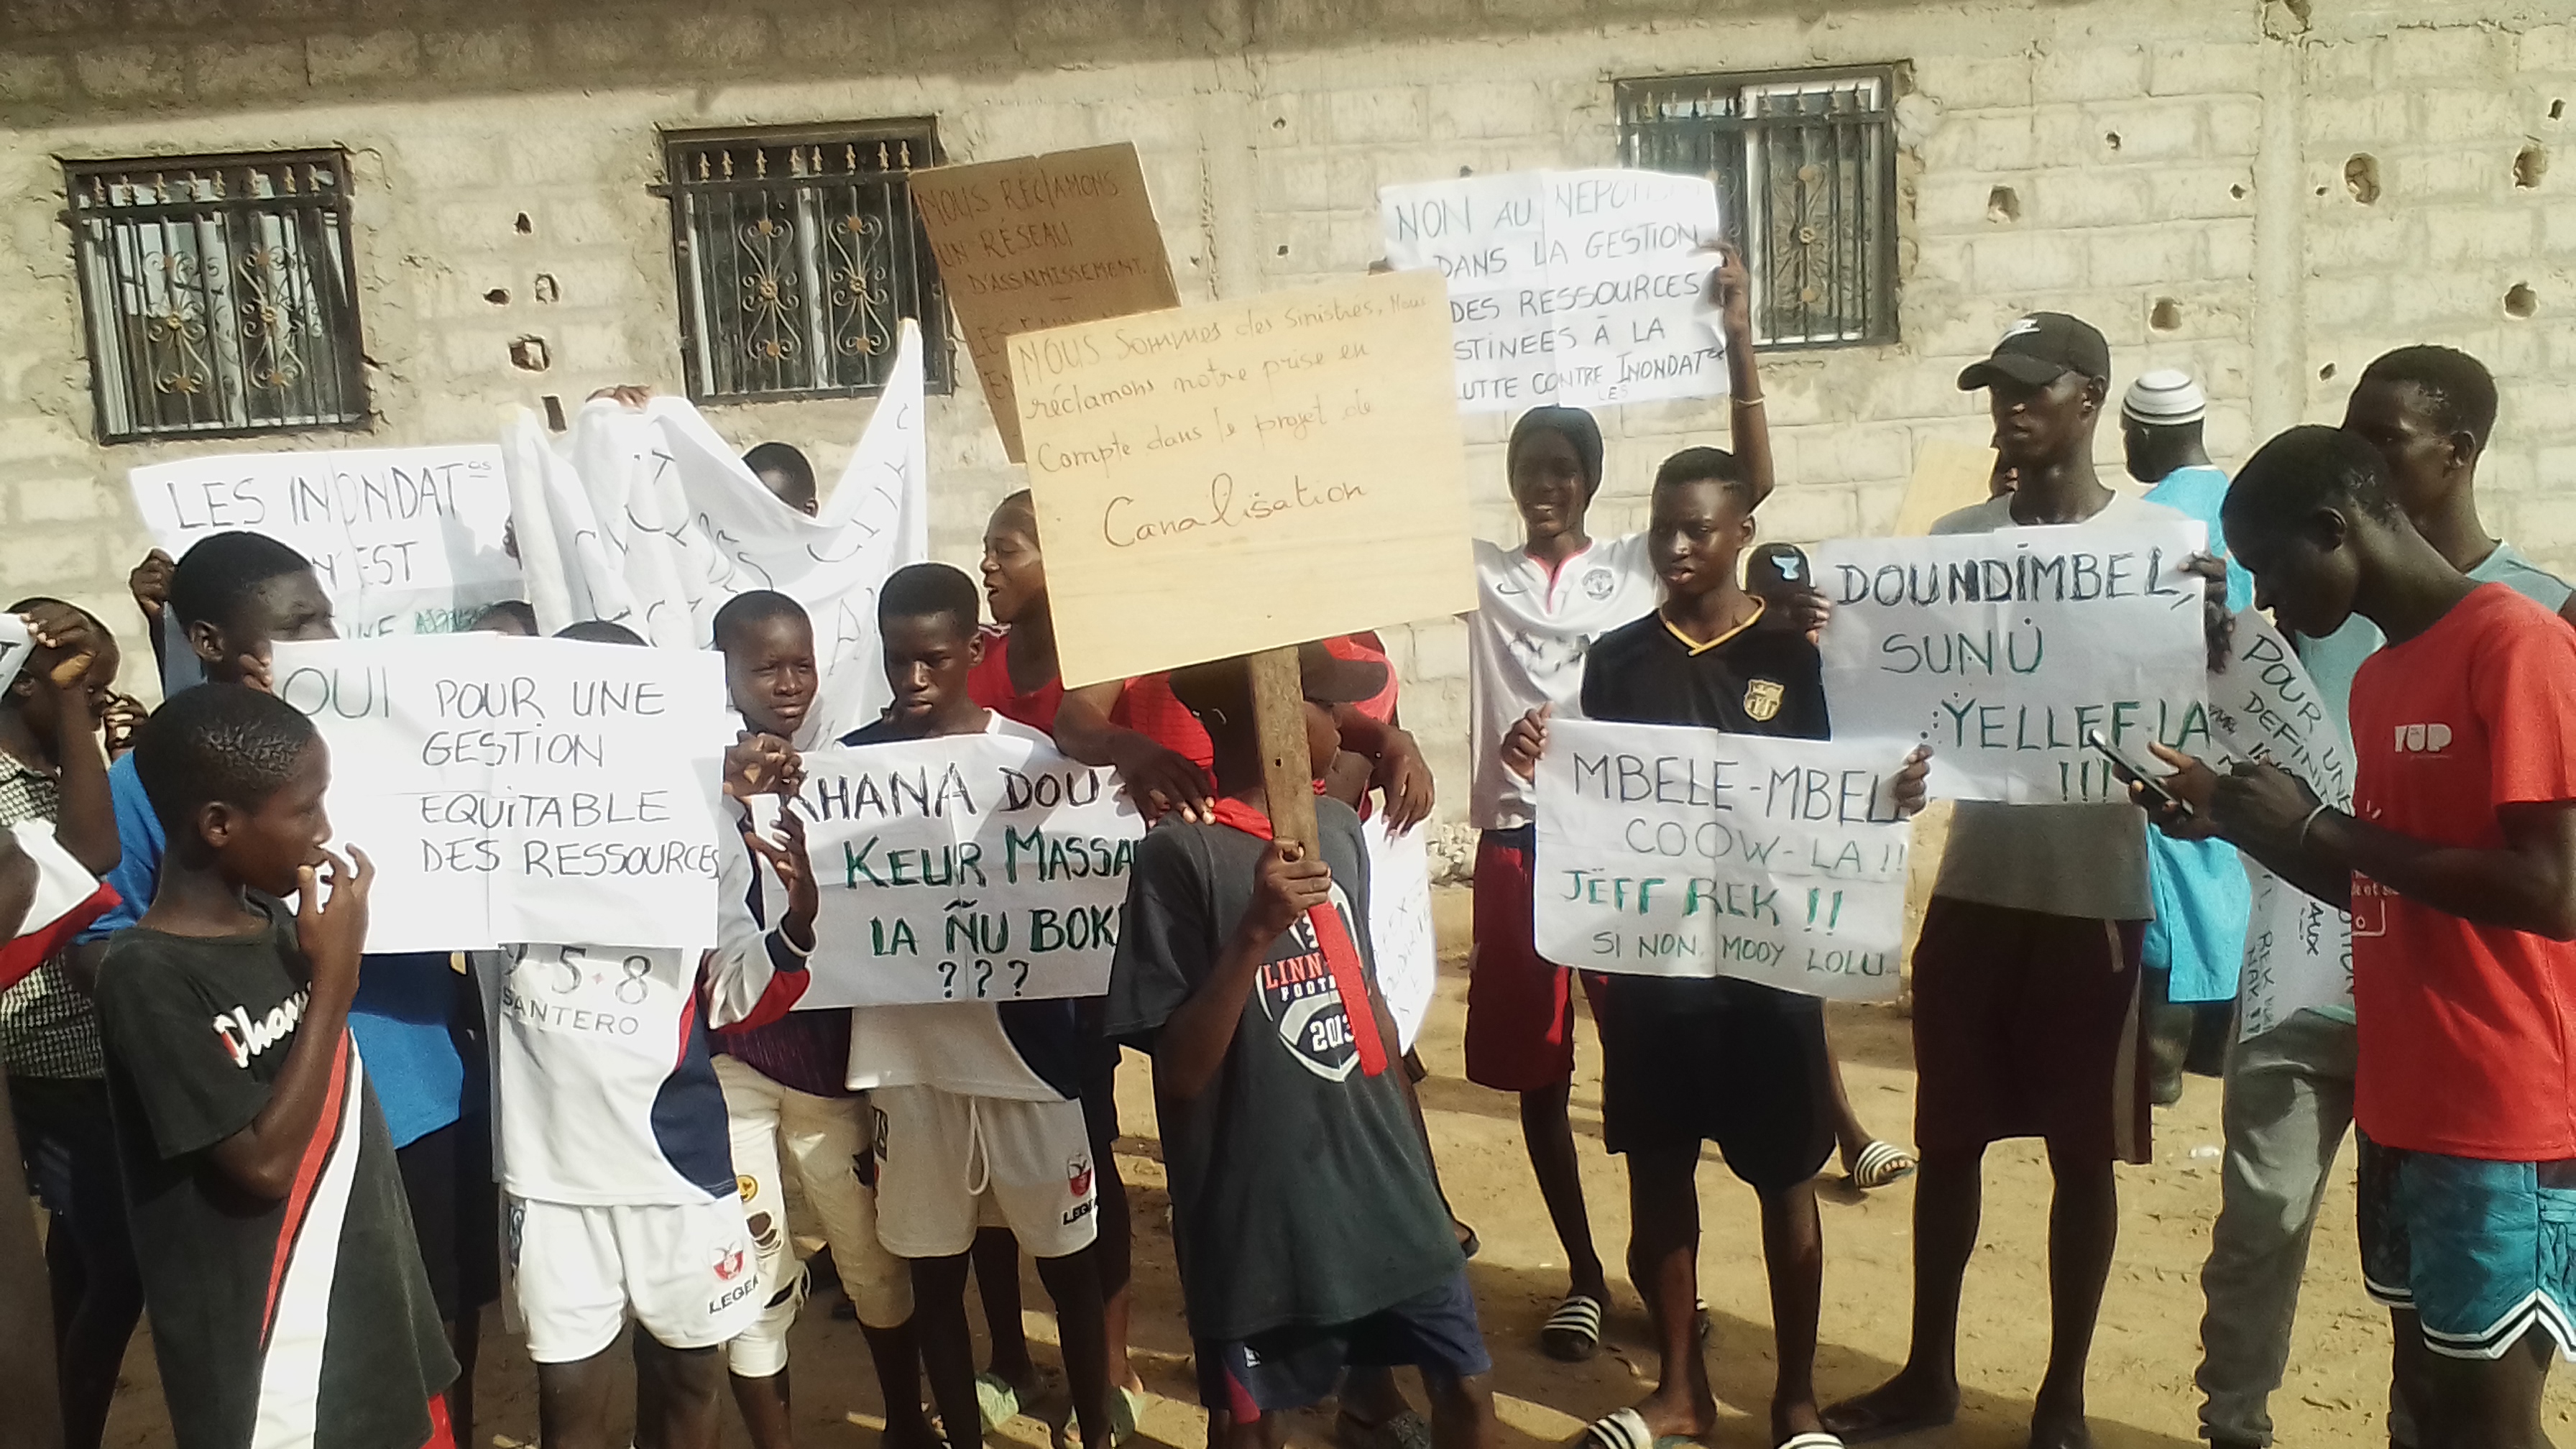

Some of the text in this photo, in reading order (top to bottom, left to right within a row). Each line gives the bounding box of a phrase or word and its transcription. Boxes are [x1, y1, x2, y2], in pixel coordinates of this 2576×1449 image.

[918, 186, 990, 226] NOUS
[1397, 196, 1472, 242] NON
[1493, 198, 1532, 229] AU
[938, 239, 969, 269] UN
[1434, 222, 1702, 279] DANS LA GESTION
[1449, 272, 1701, 323] DES RESSOURCES
[1018, 334, 1100, 387] NOUS
[1236, 309, 1272, 337] des
[1632, 316, 1666, 344] LA
[1025, 341, 1371, 420] réclamons notre prise en
[1532, 364, 1604, 395] CONTRE
[1598, 385, 1629, 400] LES
[1037, 431, 1131, 479] Compte
[1146, 425, 1202, 450] dans
[1218, 406, 1237, 444] le
[1342, 389, 1372, 415] de
[166, 477, 267, 530] LES
[1103, 472, 1368, 548] Canalisation
[282, 666, 667, 720] OUI POUR UNE
[2241, 632, 2322, 734] POUR
[422, 722, 605, 768] GESTION
[2158, 698, 2212, 750] LA
[420, 785, 672, 829] EQUITABLE
[997, 766, 1101, 814] DOU
[420, 837, 721, 880] DES RESSOURCES
[842, 824, 1141, 891] KEUR MASSA
[1682, 876, 1782, 927] REK
[1803, 887, 1844, 937] !!
[2306, 901, 2324, 957] AUX
[1263, 952, 1324, 991] LINN
[1592, 931, 1622, 958] SI
[1639, 933, 1697, 960] NON
[1721, 934, 1787, 965] MOOY
[503, 985, 639, 1036] SANTERO
